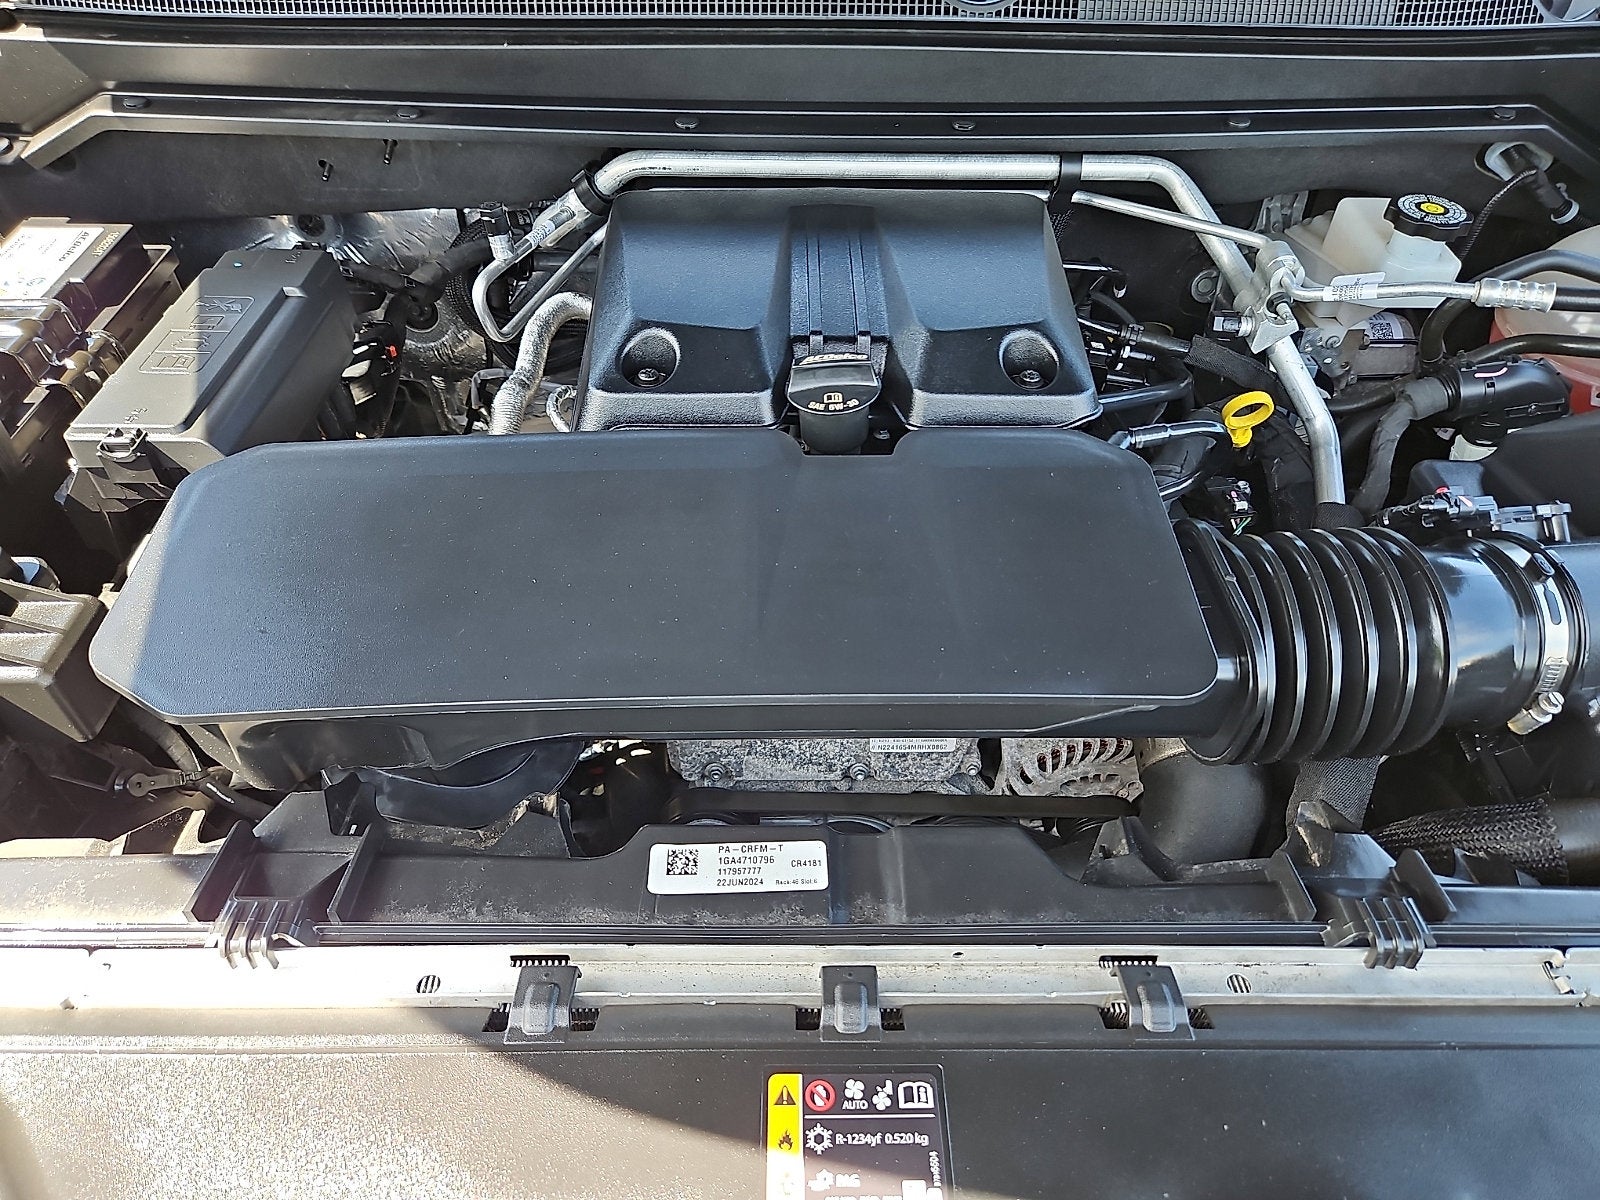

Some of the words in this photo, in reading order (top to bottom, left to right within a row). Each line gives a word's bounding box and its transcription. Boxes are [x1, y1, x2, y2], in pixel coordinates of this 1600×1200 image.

[718, 856, 775, 865] 1GA4710796
[791, 859, 822, 868] CR4181
[717, 867, 762, 876] 117957777
[716, 878, 764, 887] 22JUN2024
[842, 1100, 869, 1110] AUTO
[835, 1132, 882, 1147] R-1234yf
[884, 1132, 914, 1145] 0.520
[914, 1132, 929, 1146] kg
